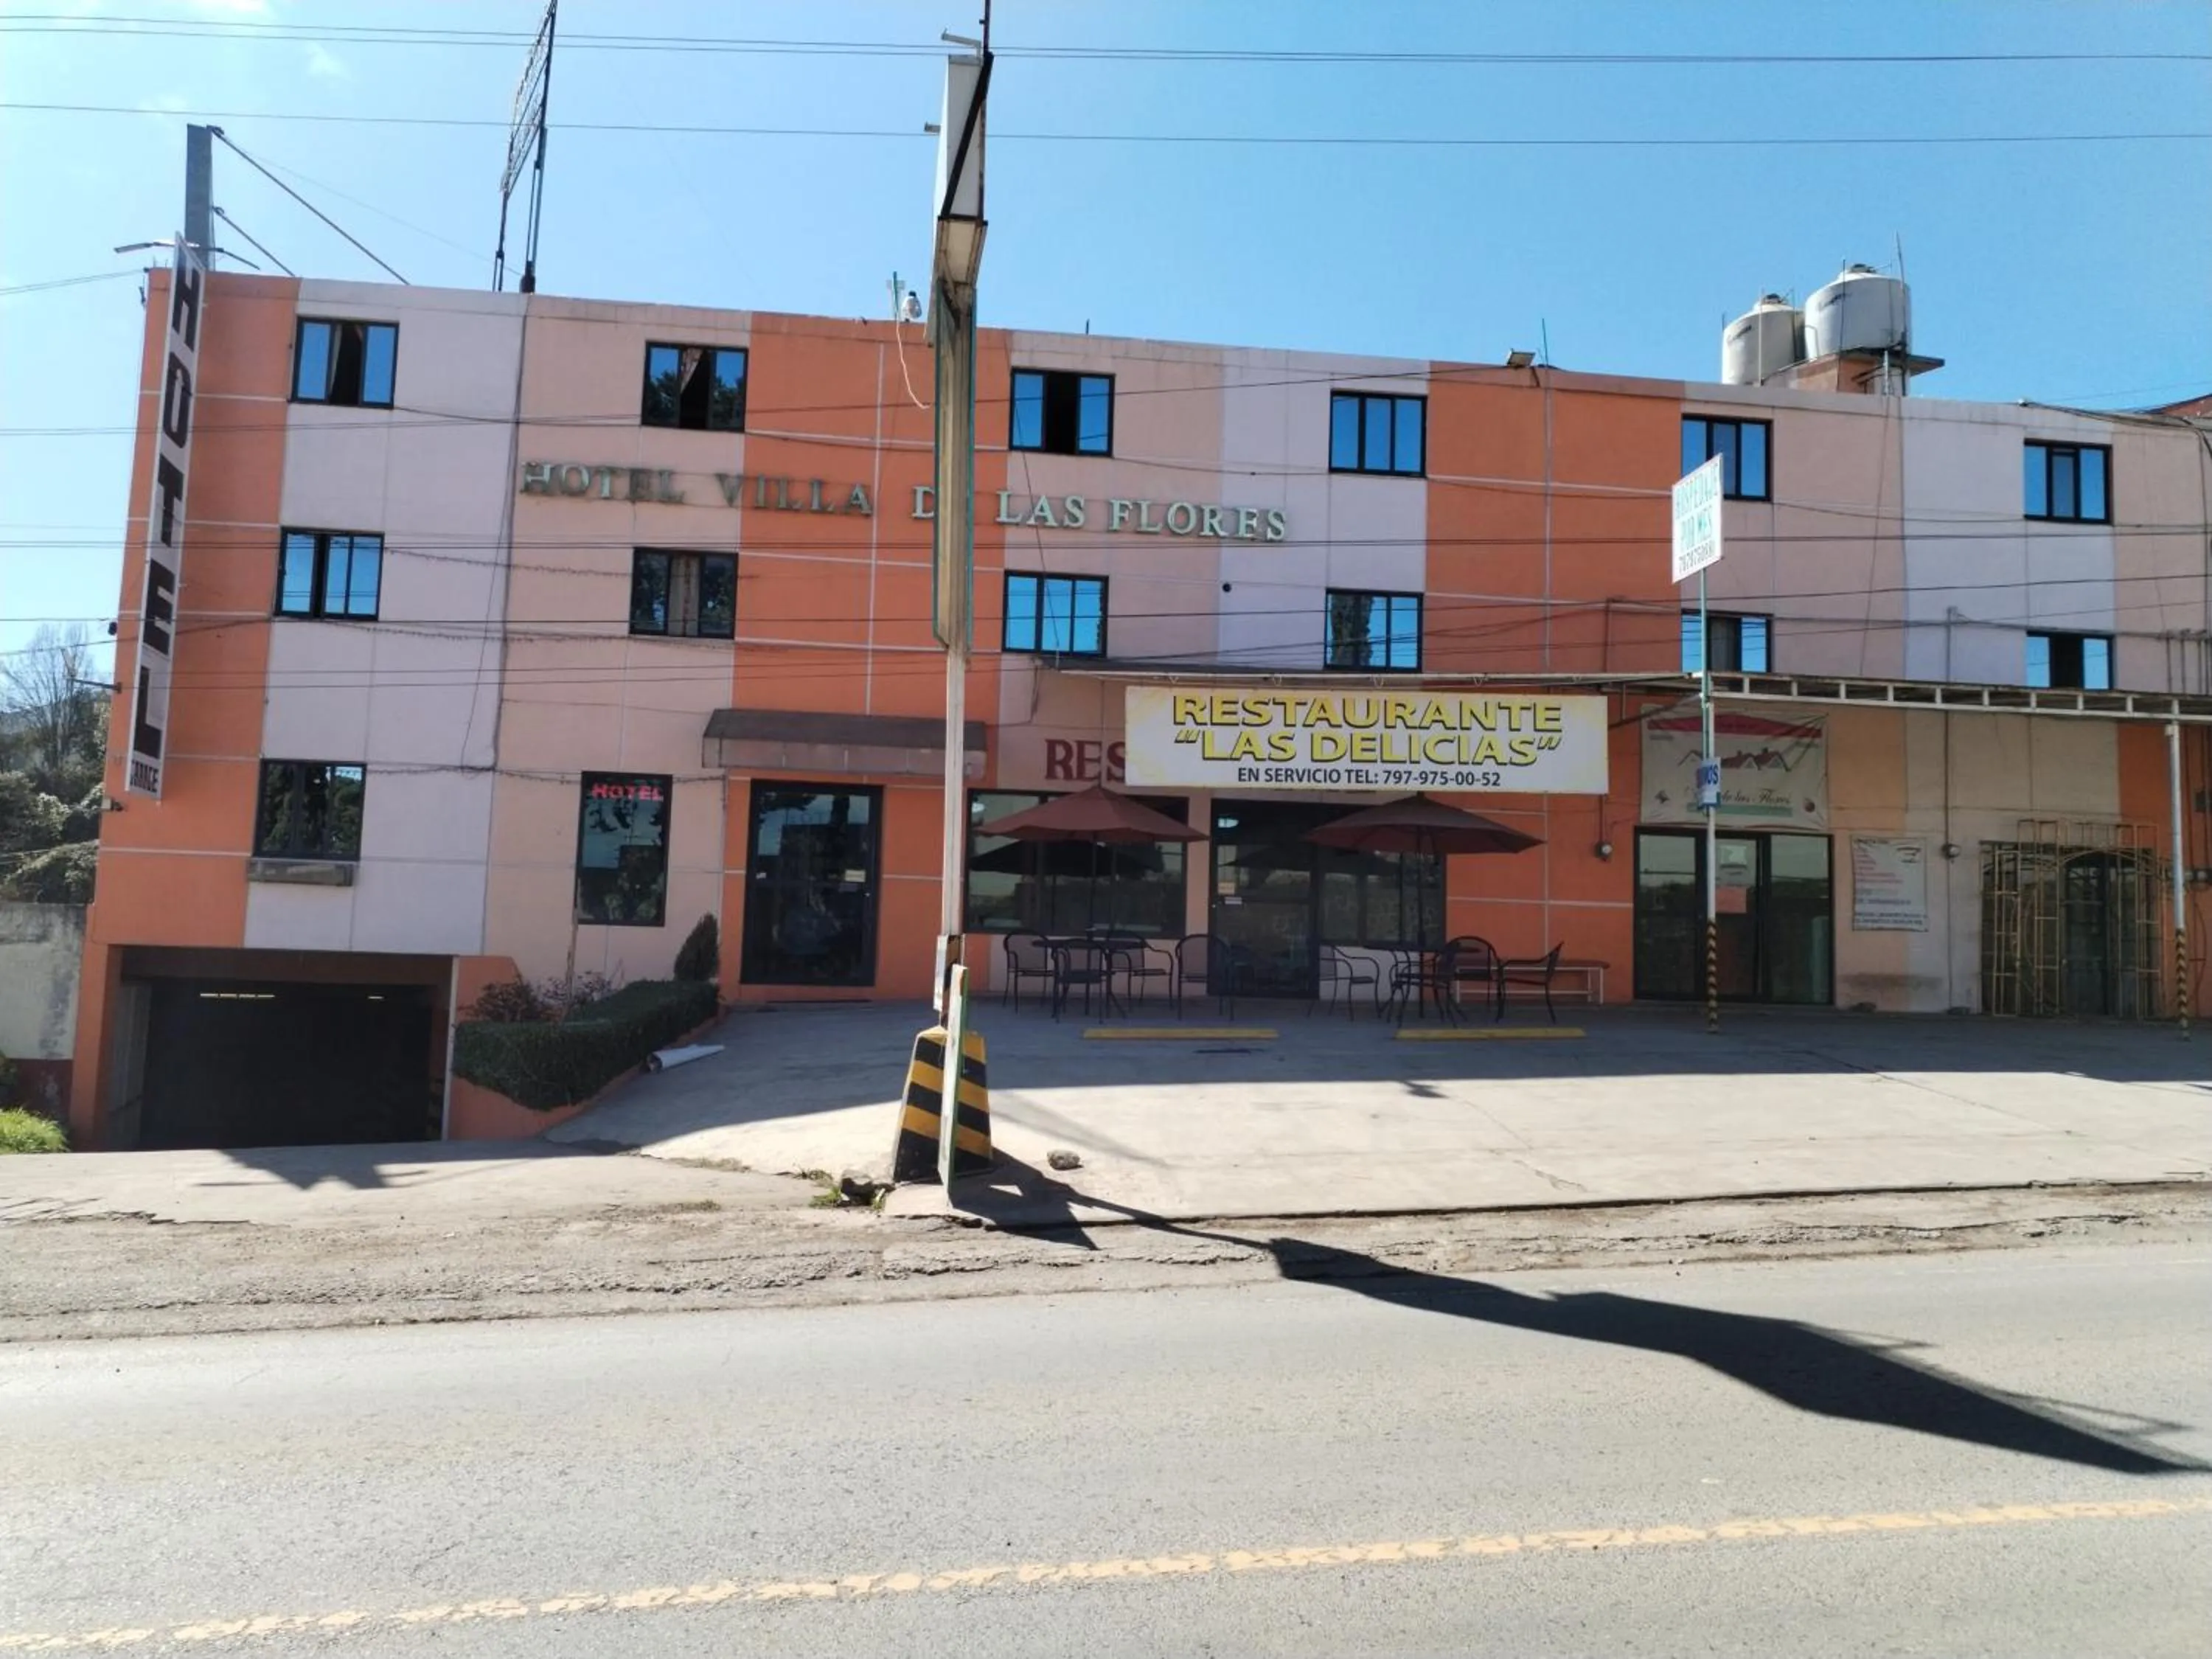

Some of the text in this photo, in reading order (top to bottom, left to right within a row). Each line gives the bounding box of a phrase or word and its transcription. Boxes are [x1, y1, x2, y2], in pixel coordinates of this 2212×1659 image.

[133, 237, 201, 759] HOTEL
[519, 461, 684, 504] HOTEL
[715, 473, 873, 518] VILLA
[996, 490, 1086, 529] LAS
[1109, 498, 1287, 542] FLORES
[1173, 695, 1562, 733] RESTAURANTE
[591, 782, 664, 802] HOTEL
[1238, 768, 1501, 787] EN SERVICIO TEL: 797-975-00-52
